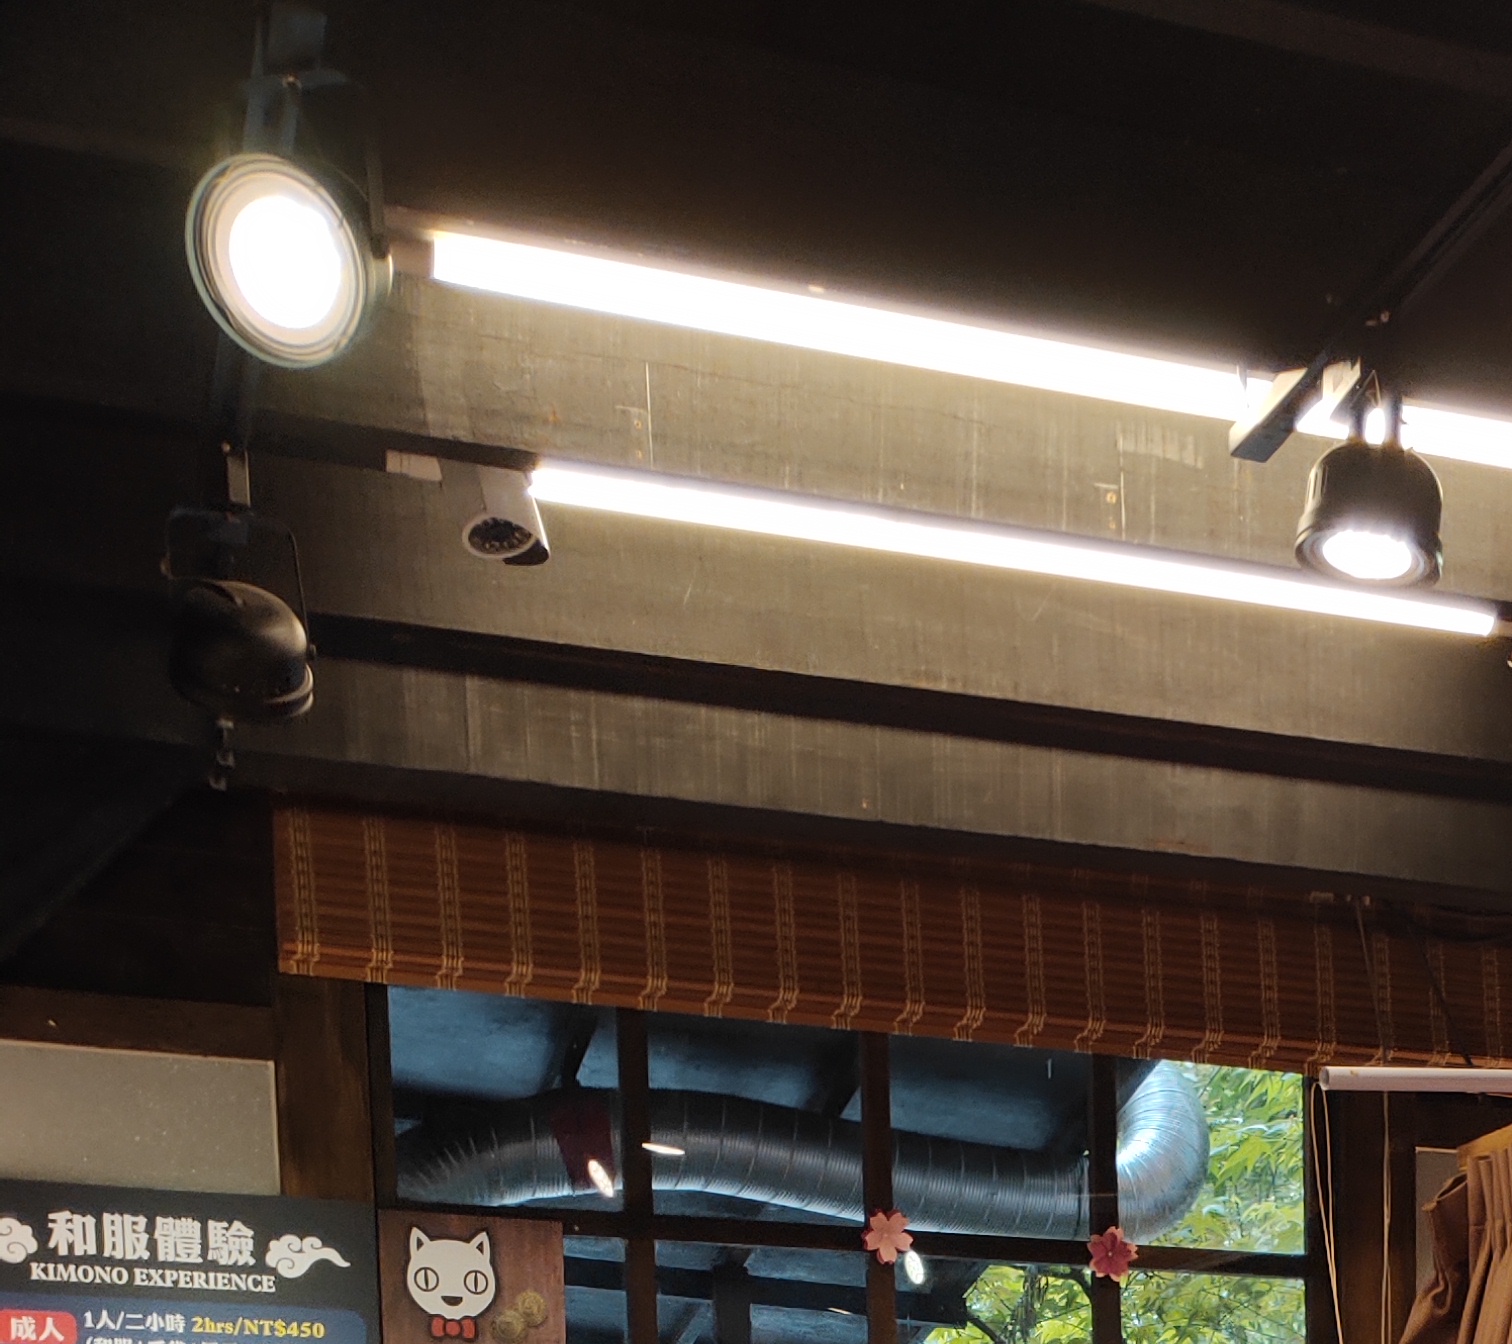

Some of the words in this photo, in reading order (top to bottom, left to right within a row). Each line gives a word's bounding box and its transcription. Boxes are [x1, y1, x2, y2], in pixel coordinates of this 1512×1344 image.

[47, 1210, 256, 1266] 和服體驗
[29, 1262, 129, 1285] KIMONO
[133, 1267, 277, 1293] EXPERIENCE
[10, 1315, 65, 1342] 成人
[83, 1309, 186, 1334] 1人/二小時
[191, 1315, 325, 1339] 2hrs/NT$450
